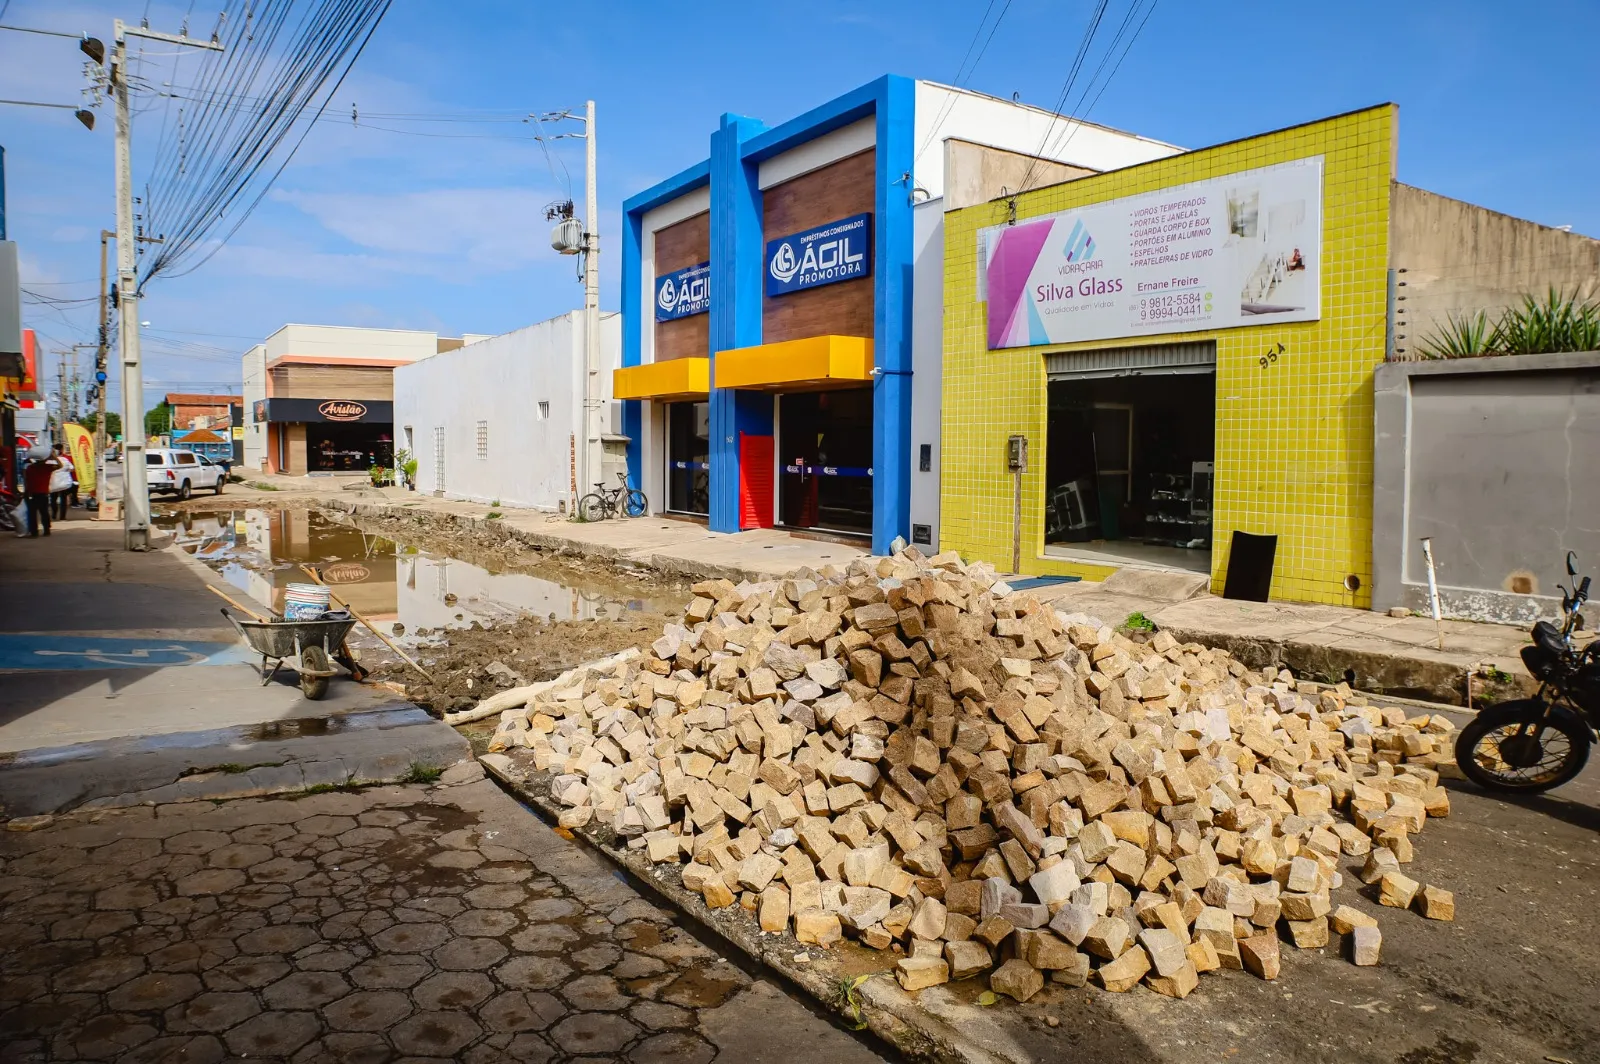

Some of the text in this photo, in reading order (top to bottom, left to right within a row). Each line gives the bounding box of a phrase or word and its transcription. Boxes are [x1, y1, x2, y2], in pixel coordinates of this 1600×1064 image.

[1133, 196, 1207, 218] VIDROS TEMPERADOS
[1133, 208, 1199, 228] PORTAS E JANELAS
[1134, 216, 1211, 238] GUARDA CORPO E BOX
[829, 219, 864, 236] CONSIGNADOS
[1166, 233, 1177, 242] EM
[800, 237, 863, 275] ÁGIL
[1134, 244, 1169, 258] ESPELHOS
[1134, 248, 1214, 267] PRATELEIRAS DE VIDRO
[799, 261, 861, 286] PROMOTORA
[1058, 259, 1104, 275] VIDRAÇARIA
[1037, 276, 1123, 303] Silva Glass
[1137, 276, 1199, 292] Ernane Freire
[677, 298, 710, 314] PROMOTO
[1140, 292, 1201, 310] 9 9812-5584
[1140, 309, 1147, 321] 9
[1149, 303, 1201, 320] 9994-0441
[1259, 342, 1286, 370] 954
[323, 402, 363, 415] Avistão
